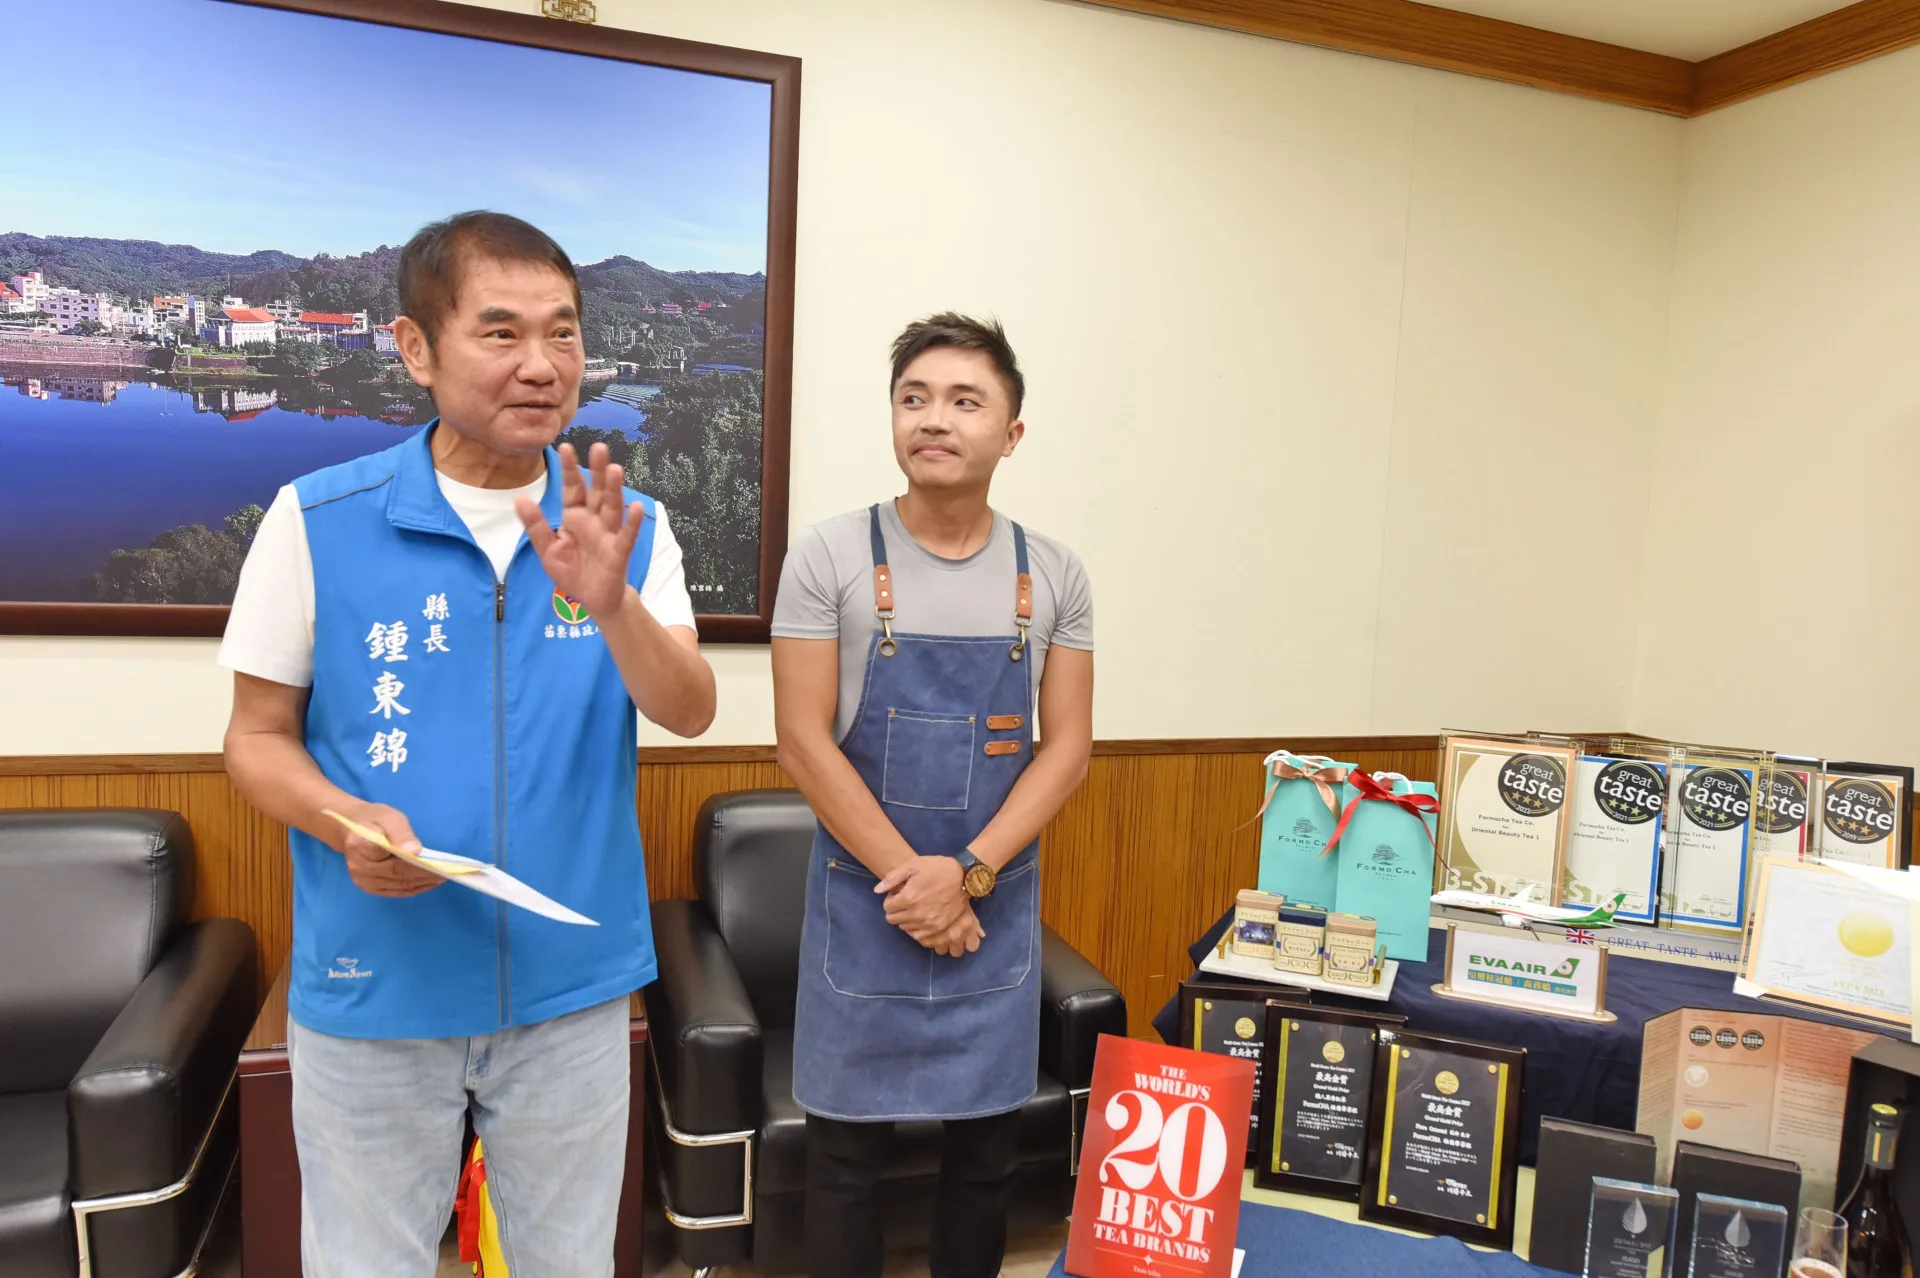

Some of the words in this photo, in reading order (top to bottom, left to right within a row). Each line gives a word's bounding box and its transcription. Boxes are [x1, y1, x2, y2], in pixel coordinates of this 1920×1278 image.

[422, 592, 452, 654] 縣長
[544, 624, 601, 639] 苗栗縣政
[364, 620, 411, 773] 鍾東錦
[1520, 763, 1554, 781] great
[1617, 770, 1653, 788] great
[1503, 769, 1562, 803] taste
[1600, 775, 1661, 811] taste
[1702, 776, 1739, 794] great
[1685, 782, 1748, 817] taste
[1756, 791, 1805, 819] aste
[1844, 788, 1882, 807] great
[1612, 811, 1627, 821] 2021
[1826, 794, 1893, 830] taste
[1699, 818, 1714, 827] 2021
[1314, 839, 1327, 847] CH
[1498, 830, 1520, 838] Beauty
[1842, 832, 1857, 841] 2019
[1608, 936, 1650, 951] GREAT
[1658, 943, 1698, 958] TASTE
[1716, 1035, 1737, 1043] taste
[1742, 1037, 1764, 1045] taste
[1160, 1065, 1187, 1080] THE
[1134, 1072, 1211, 1101] WORLD'S
[1427, 1102, 1463, 1118] 最高金賞
[1099, 1089, 1227, 1201] 20
[1096, 1185, 1214, 1245] BEST
[1094, 1223, 1128, 1245] TEA
[1133, 1232, 1211, 1264] BRANDS
